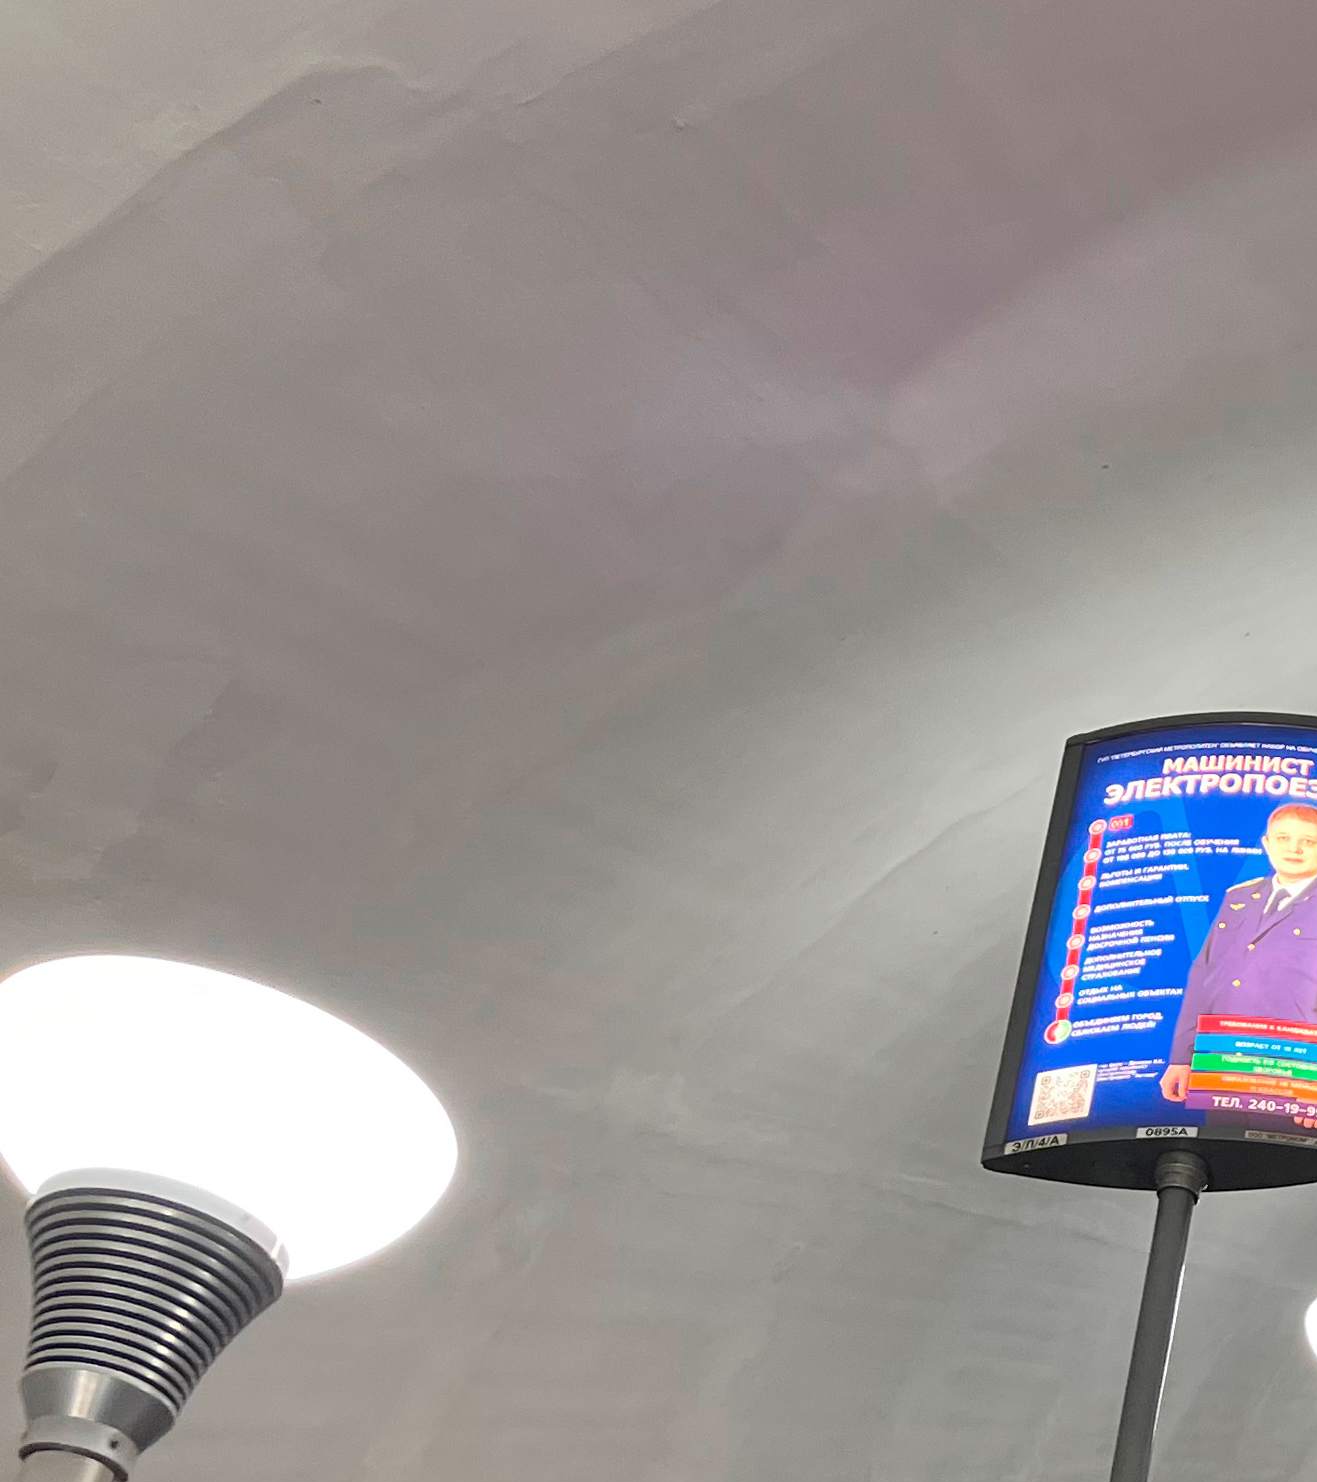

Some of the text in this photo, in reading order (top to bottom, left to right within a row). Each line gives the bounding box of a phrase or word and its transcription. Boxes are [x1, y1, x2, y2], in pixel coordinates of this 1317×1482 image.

[1162, 755, 1315, 775] МАШИНИСТ
[1212, 1096, 1242, 1108] ТЕЛ.
[1012, 1135, 1060, 1152] Э/П/4/А
